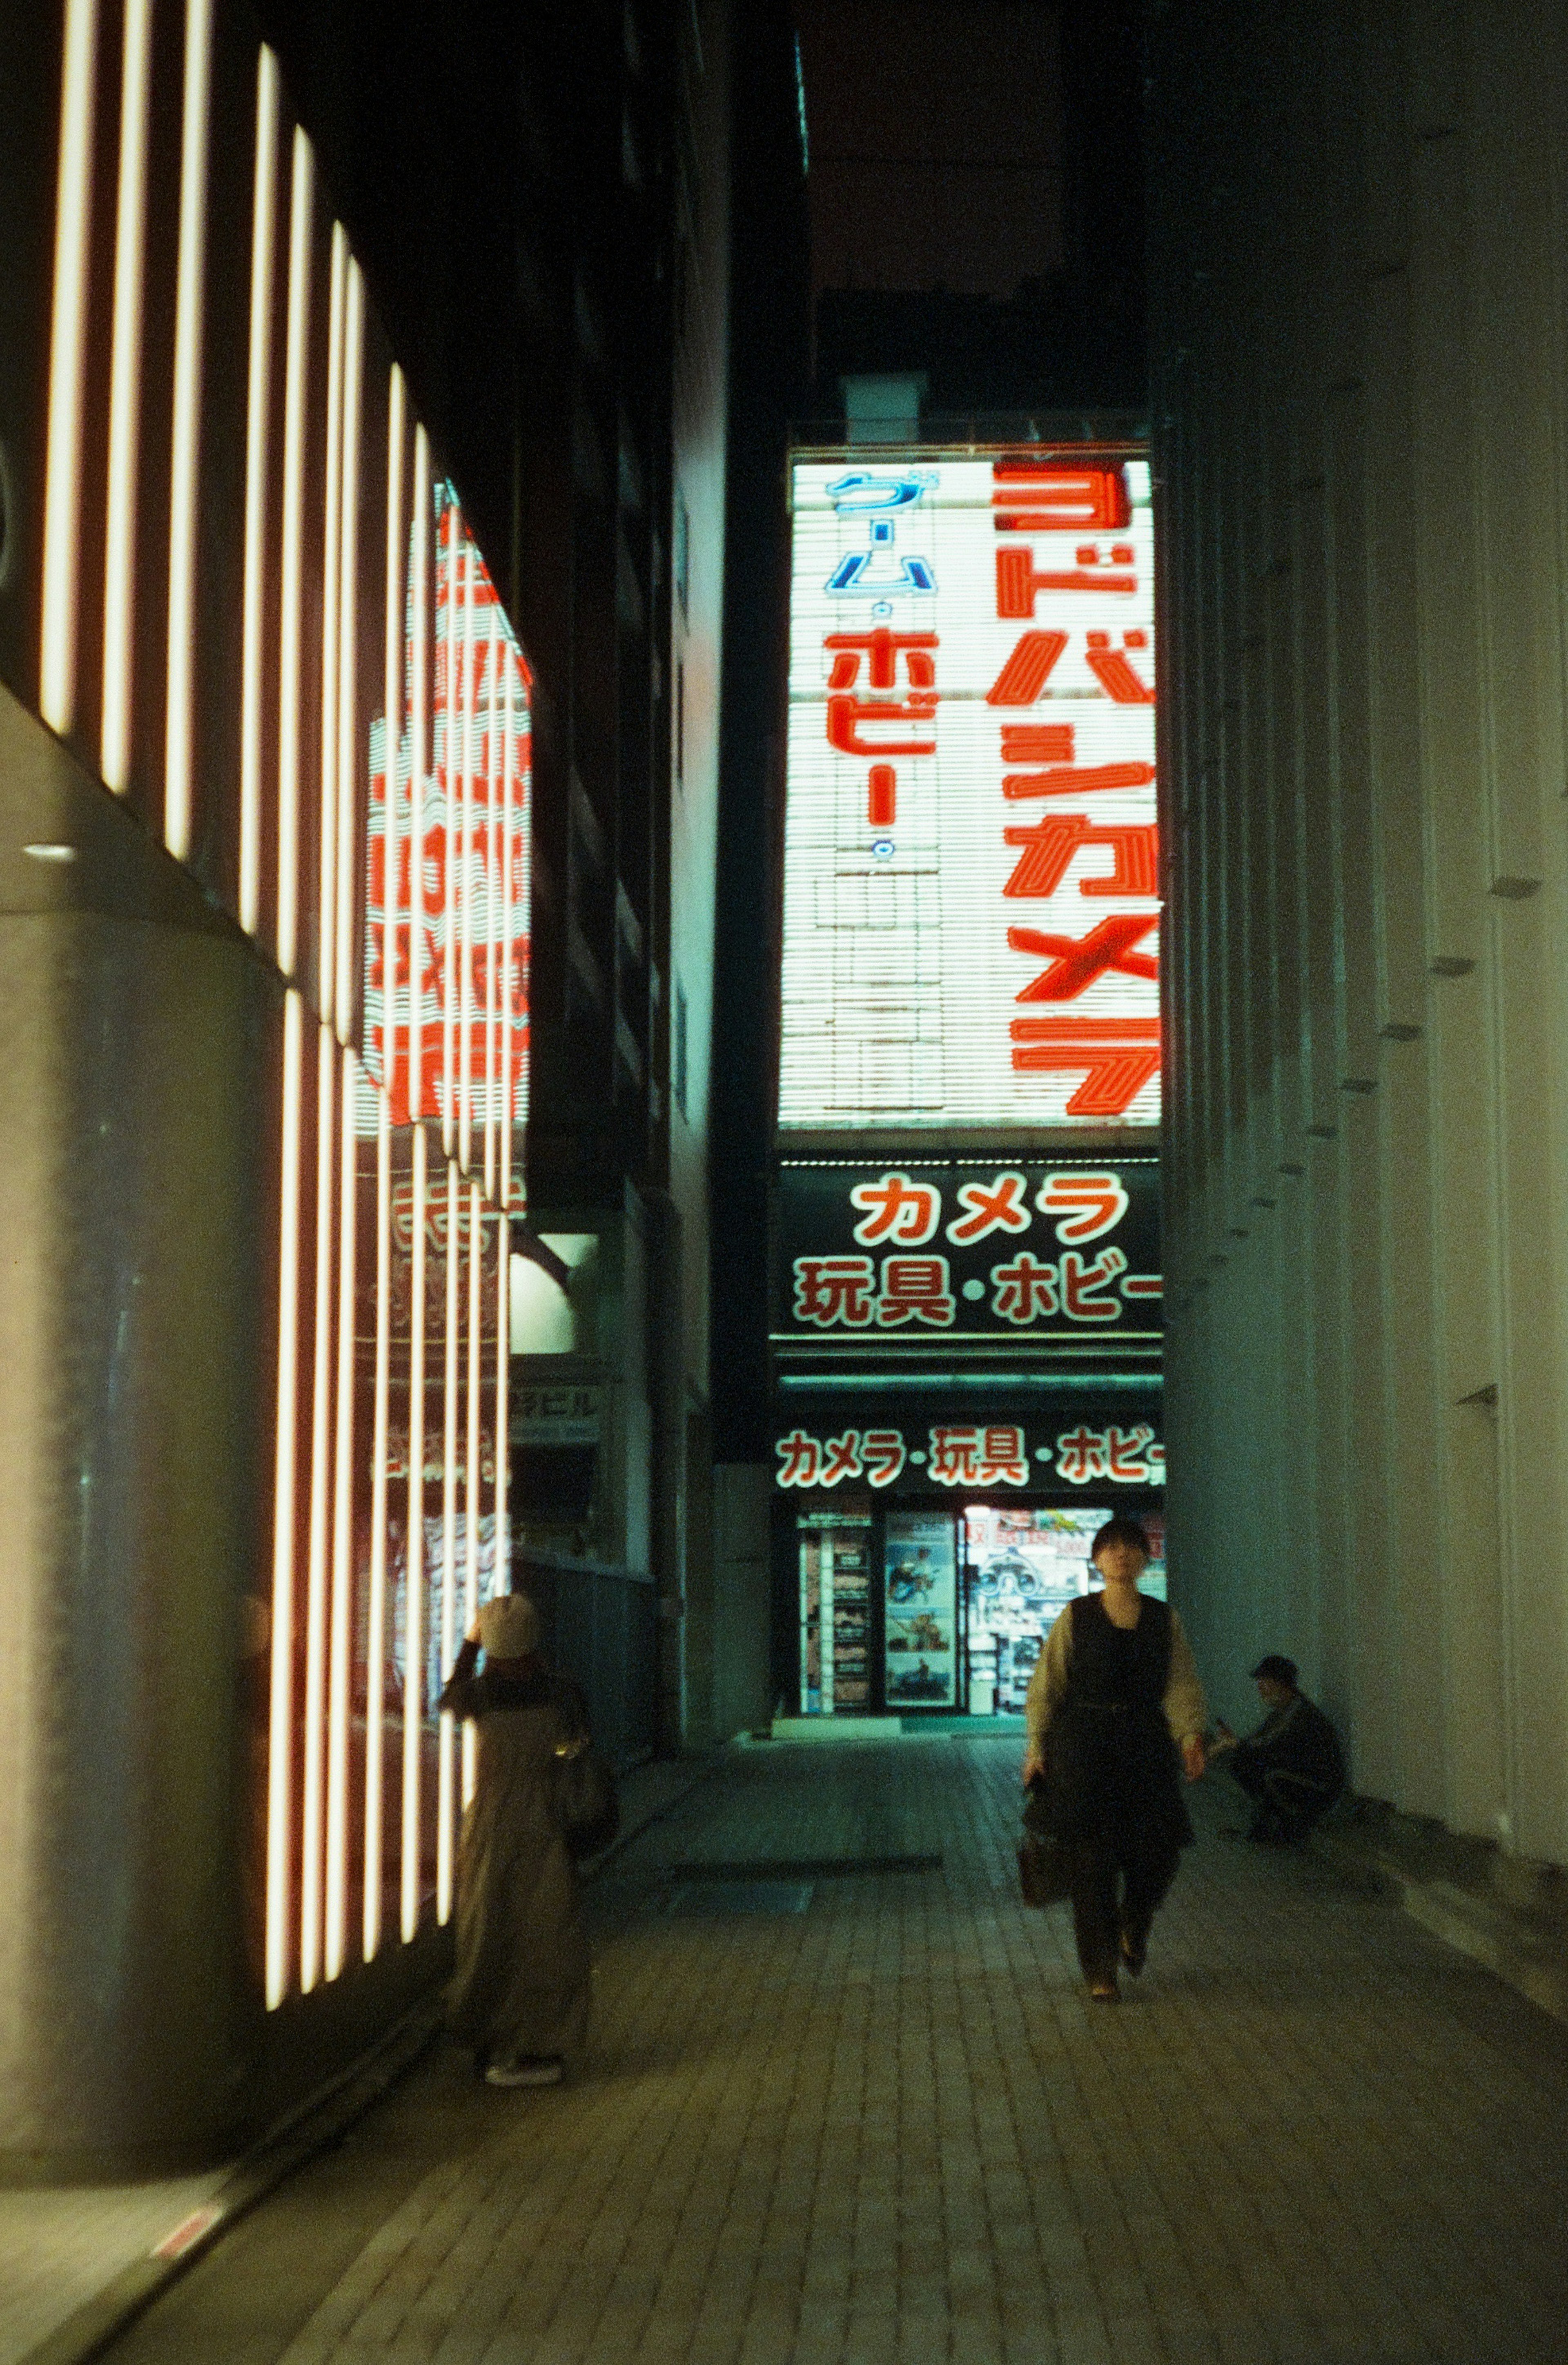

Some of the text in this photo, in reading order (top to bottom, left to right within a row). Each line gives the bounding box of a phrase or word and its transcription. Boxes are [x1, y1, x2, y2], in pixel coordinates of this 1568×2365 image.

[986, 461, 1162, 1116] ヨドバシカメラ
[850, 1170, 1129, 1247] カメラ
[792, 1245, 1163, 1327] 玩具・ホビー
